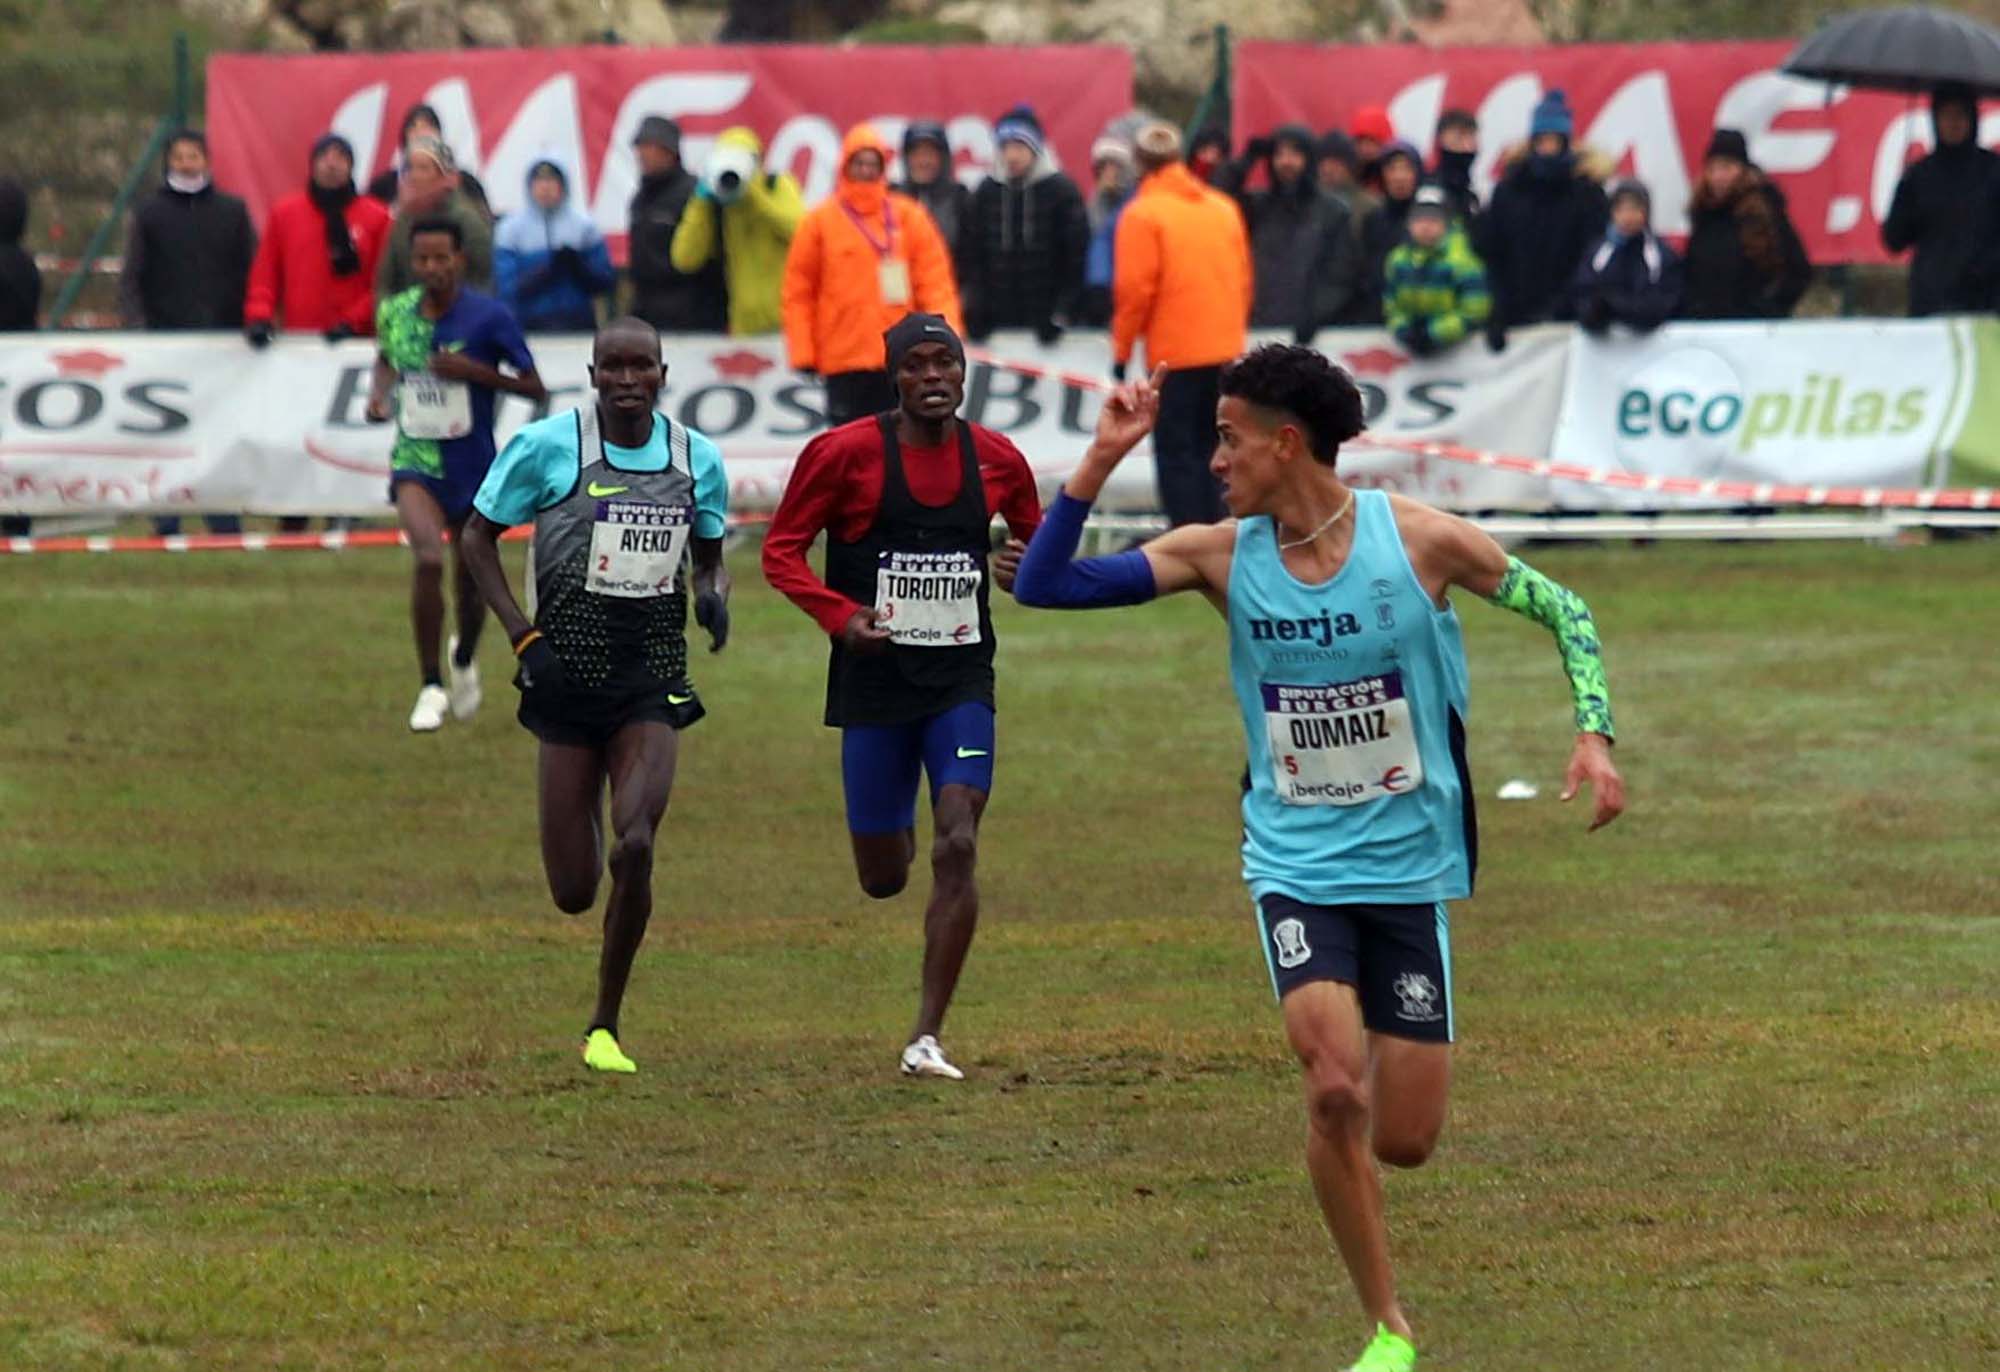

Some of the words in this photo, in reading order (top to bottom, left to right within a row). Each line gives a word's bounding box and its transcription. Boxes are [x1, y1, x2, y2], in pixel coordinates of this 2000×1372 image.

[1617, 373, 1929, 454] ecopilas
[607, 513, 683, 525] BURGOS
[608, 503, 685, 515] DIPUTACIÓN
[620, 529, 671, 552] AYEKO
[598, 555, 608, 571] 2
[891, 562, 971, 573] BURGOS
[884, 603, 894, 620] 3
[1249, 608, 1361, 647] nerja
[1278, 678, 1383, 700] DIPUTACIÓN
[1279, 691, 1387, 714] BURGOS
[1289, 709, 1390, 749] OUMAIZ
[1284, 755, 1298, 776] 5
